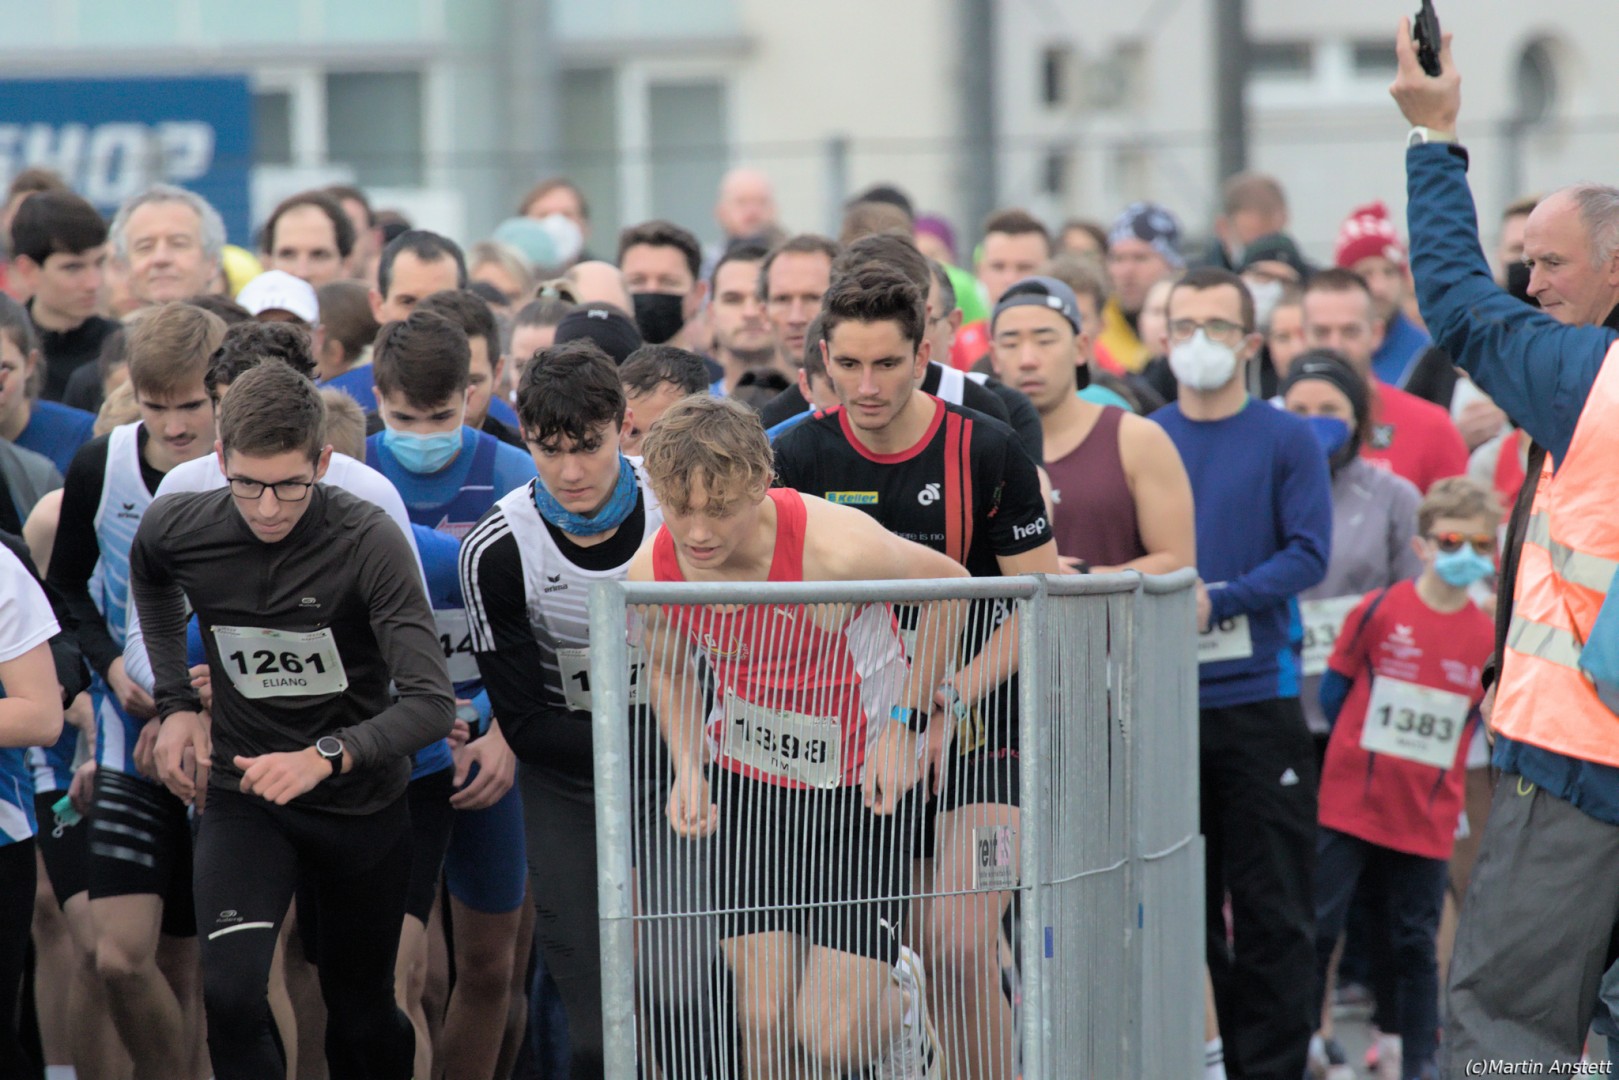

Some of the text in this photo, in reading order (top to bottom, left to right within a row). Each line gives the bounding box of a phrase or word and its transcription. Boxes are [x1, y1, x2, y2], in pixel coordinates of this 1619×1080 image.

[838, 493, 876, 504] Keller
[919, 532, 928, 541] is
[930, 533, 945, 541] no
[1012, 517, 1046, 541] hep
[543, 583, 569, 593] erima
[230, 650, 326, 675] 1261
[263, 678, 307, 688] ELIANO
[1378, 704, 1454, 741] 1383
[735, 718, 826, 764] 1398
